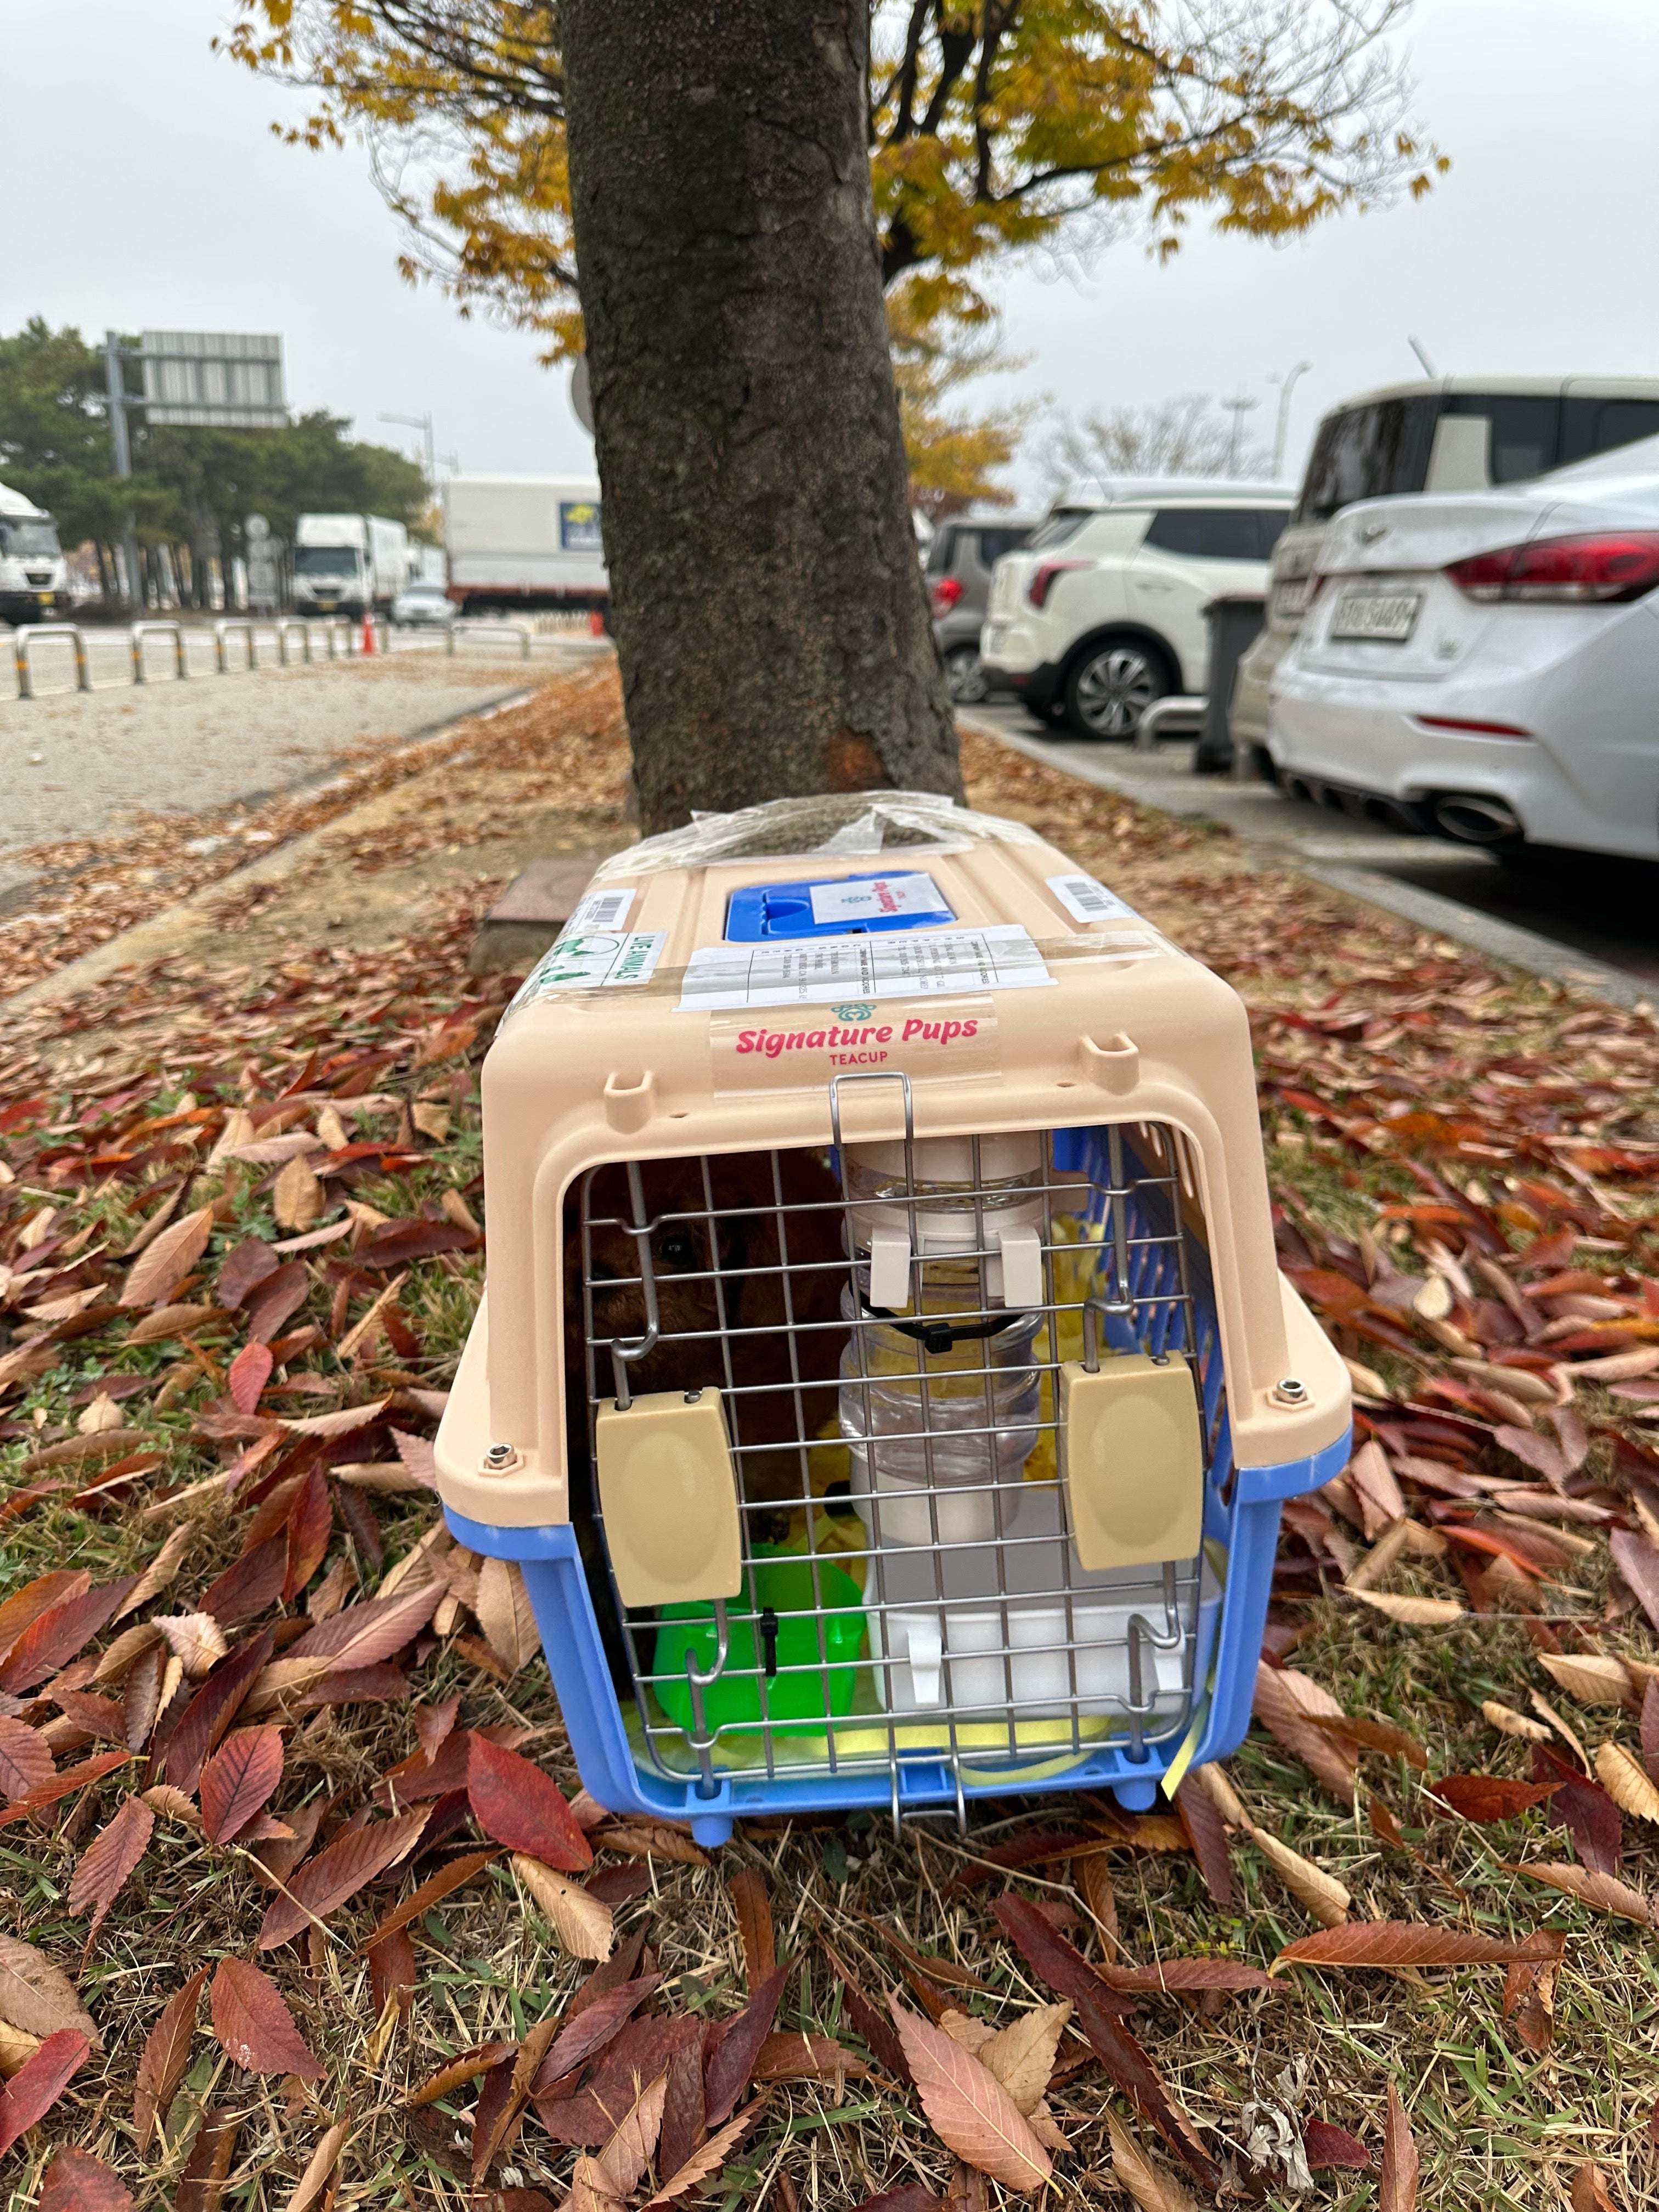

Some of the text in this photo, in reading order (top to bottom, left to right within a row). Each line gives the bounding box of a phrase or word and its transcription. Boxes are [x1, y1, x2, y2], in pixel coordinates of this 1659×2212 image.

[614, 936, 656, 979] LIVE ANIMALS
[736, 1019, 978, 1058] Signature Pups
[830, 1051, 888, 1065] TEACUP
